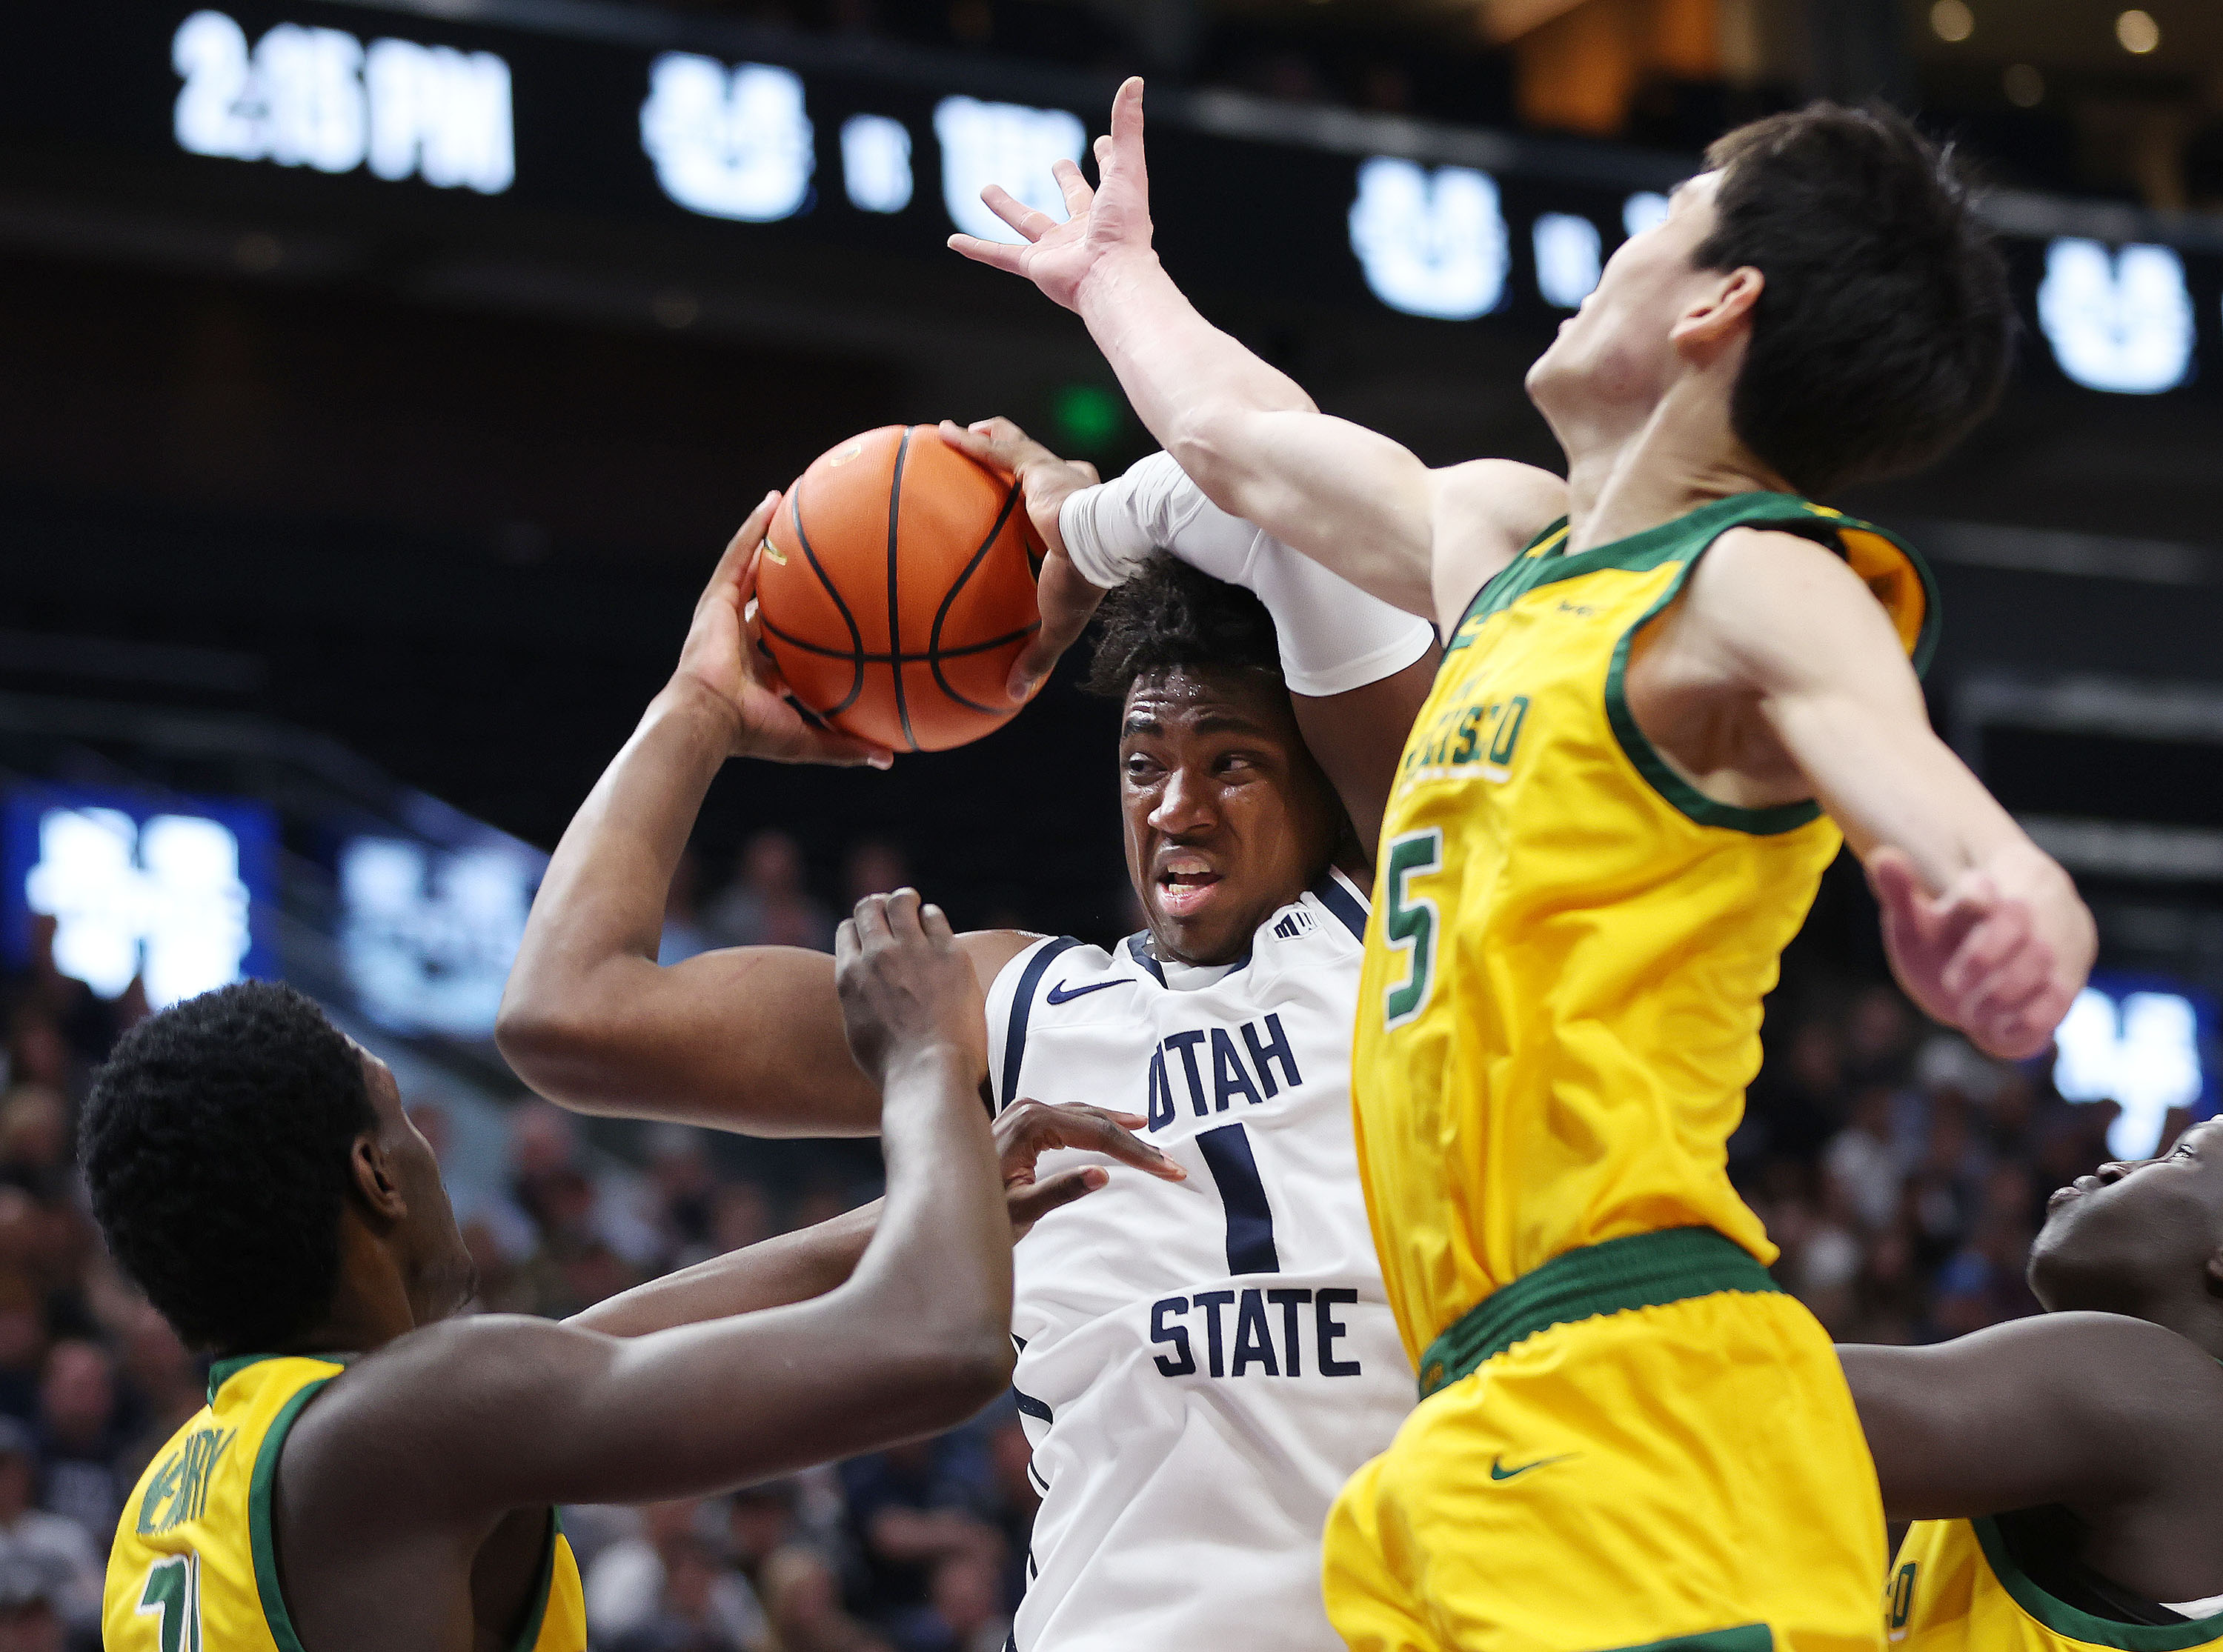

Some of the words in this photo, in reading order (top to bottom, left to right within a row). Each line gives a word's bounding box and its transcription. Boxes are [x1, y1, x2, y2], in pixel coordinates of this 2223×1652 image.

[1384, 827, 1443, 1033] 5
[1148, 1013, 1302, 1133] UTAH
[1195, 1122, 1280, 1276] 1
[1151, 1289, 1361, 1378] STATE
